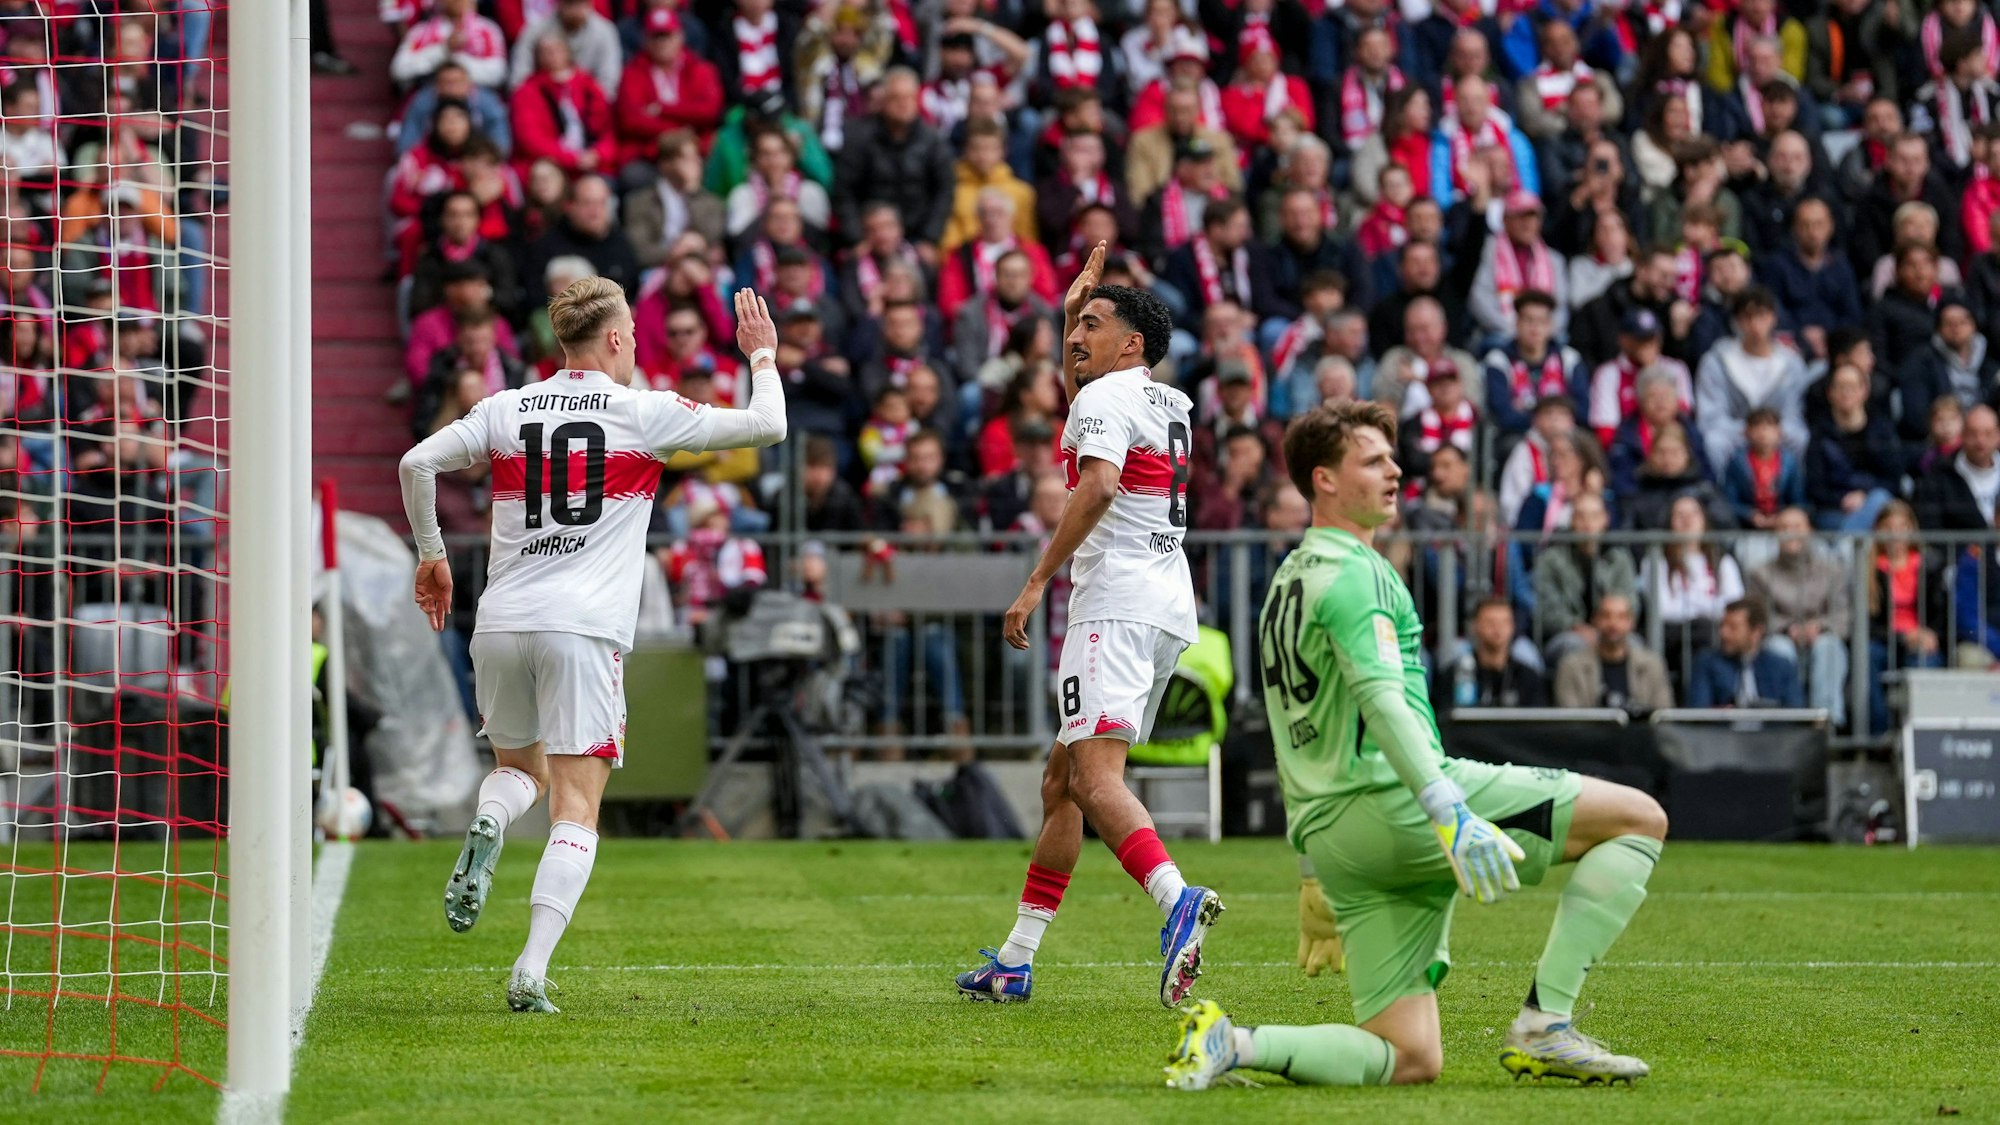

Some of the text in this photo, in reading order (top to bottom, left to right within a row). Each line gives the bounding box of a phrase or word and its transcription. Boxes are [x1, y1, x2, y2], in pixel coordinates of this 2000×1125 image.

[519, 393, 612, 412] STUTTGART
[519, 421, 606, 529] 10
[1168, 421, 1190, 527] 8
[1150, 532, 1179, 554] TIAGO
[1262, 578, 1319, 710] 40
[1063, 675, 1081, 717] 8
[1067, 717, 1087, 730] JAKO
[551, 839, 588, 852] JAKO
